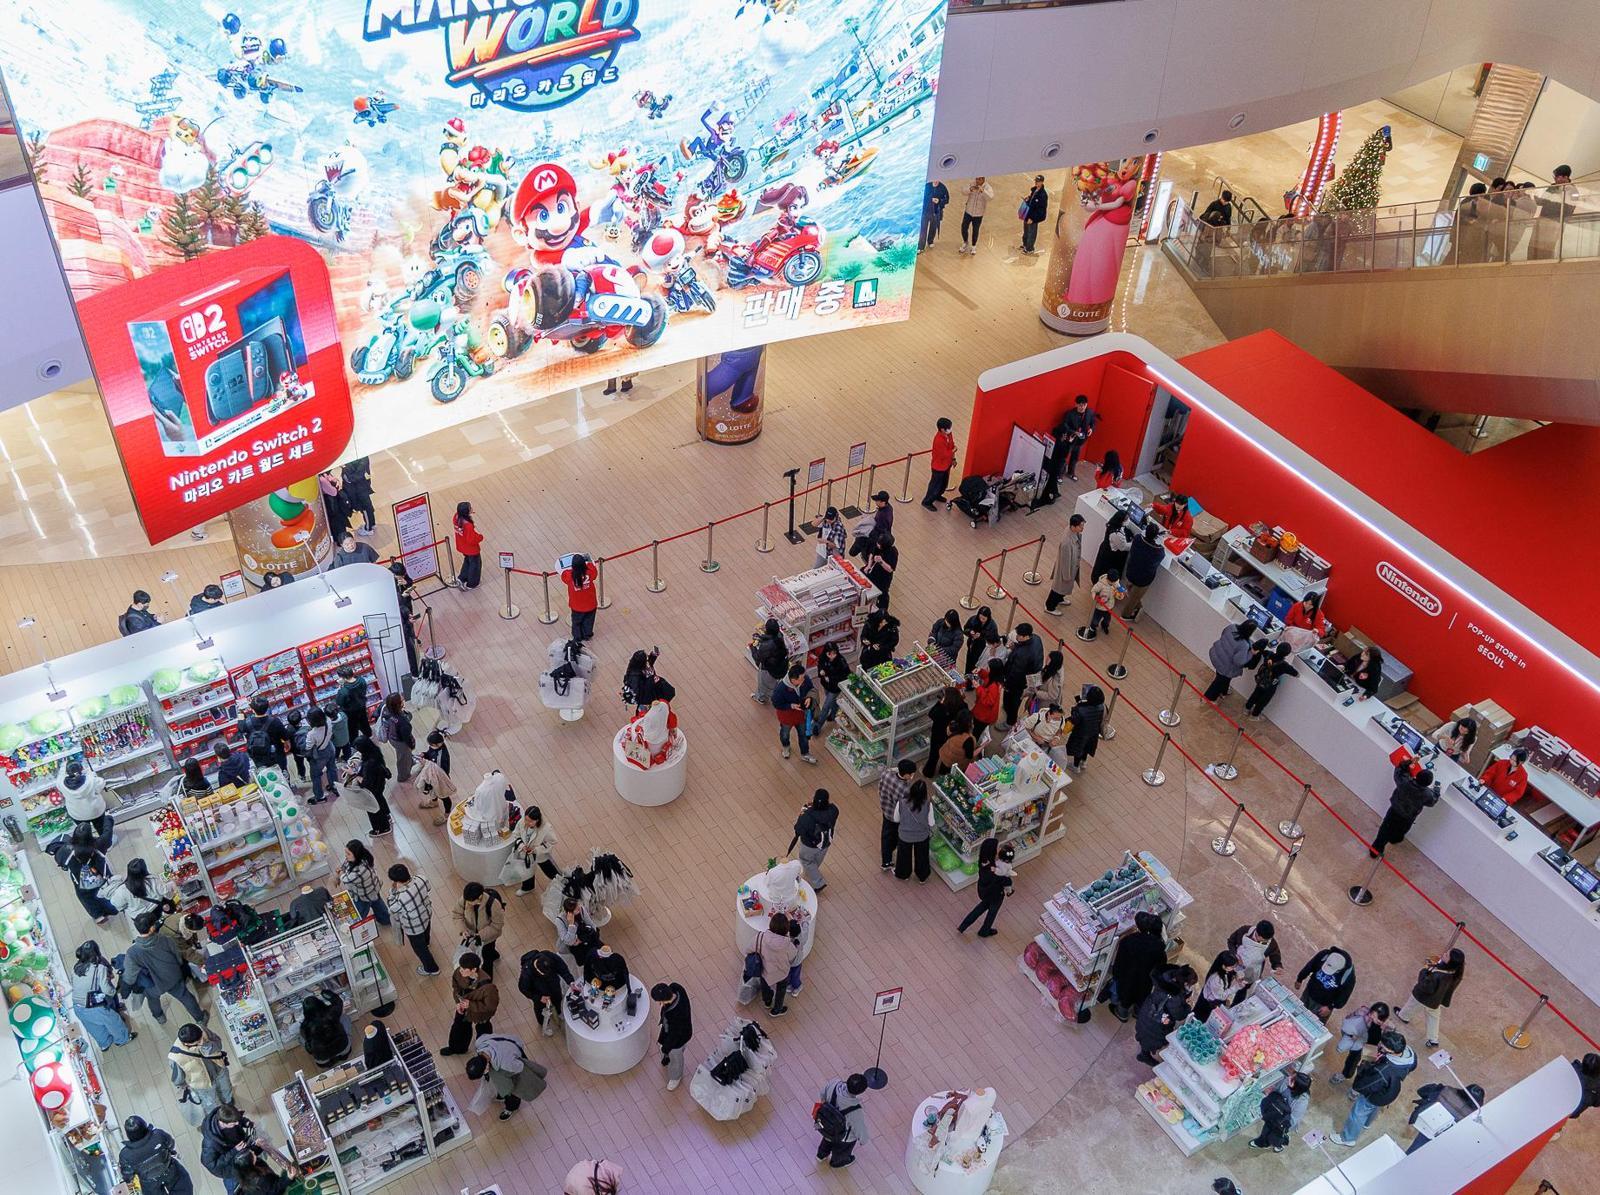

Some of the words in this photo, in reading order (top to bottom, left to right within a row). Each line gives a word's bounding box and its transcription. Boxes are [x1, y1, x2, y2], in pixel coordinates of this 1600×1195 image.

[449, 0, 632, 70] WORLD
[470, 83, 527, 108] 마리오
[537, 75, 573, 94] 카트
[581, 67, 618, 86] 월드
[537, 172, 556, 190] M
[206, 303, 227, 333] 2
[743, 285, 806, 329] 판매
[814, 279, 847, 316] 중
[1072, 310, 1101, 318] LOTTE
[187, 330, 228, 353] NINTENDO
[188, 336, 231, 361] SWITCH
[169, 450, 249, 491] Nintendo
[251, 426, 309, 457] Switch
[311, 417, 323, 434] 2
[183, 480, 225, 503] 마리오
[228, 464, 255, 484] 카트
[258, 453, 285, 473] 월드
[288, 441, 315, 460] 세트
[260, 560, 298, 571] LOTTE
[1381, 565, 1438, 612] Nintendo
[1467, 622, 1495, 644] POP-UP
[1494, 642, 1518, 663] STORE
[1477, 644, 1505, 669] SEOUL
